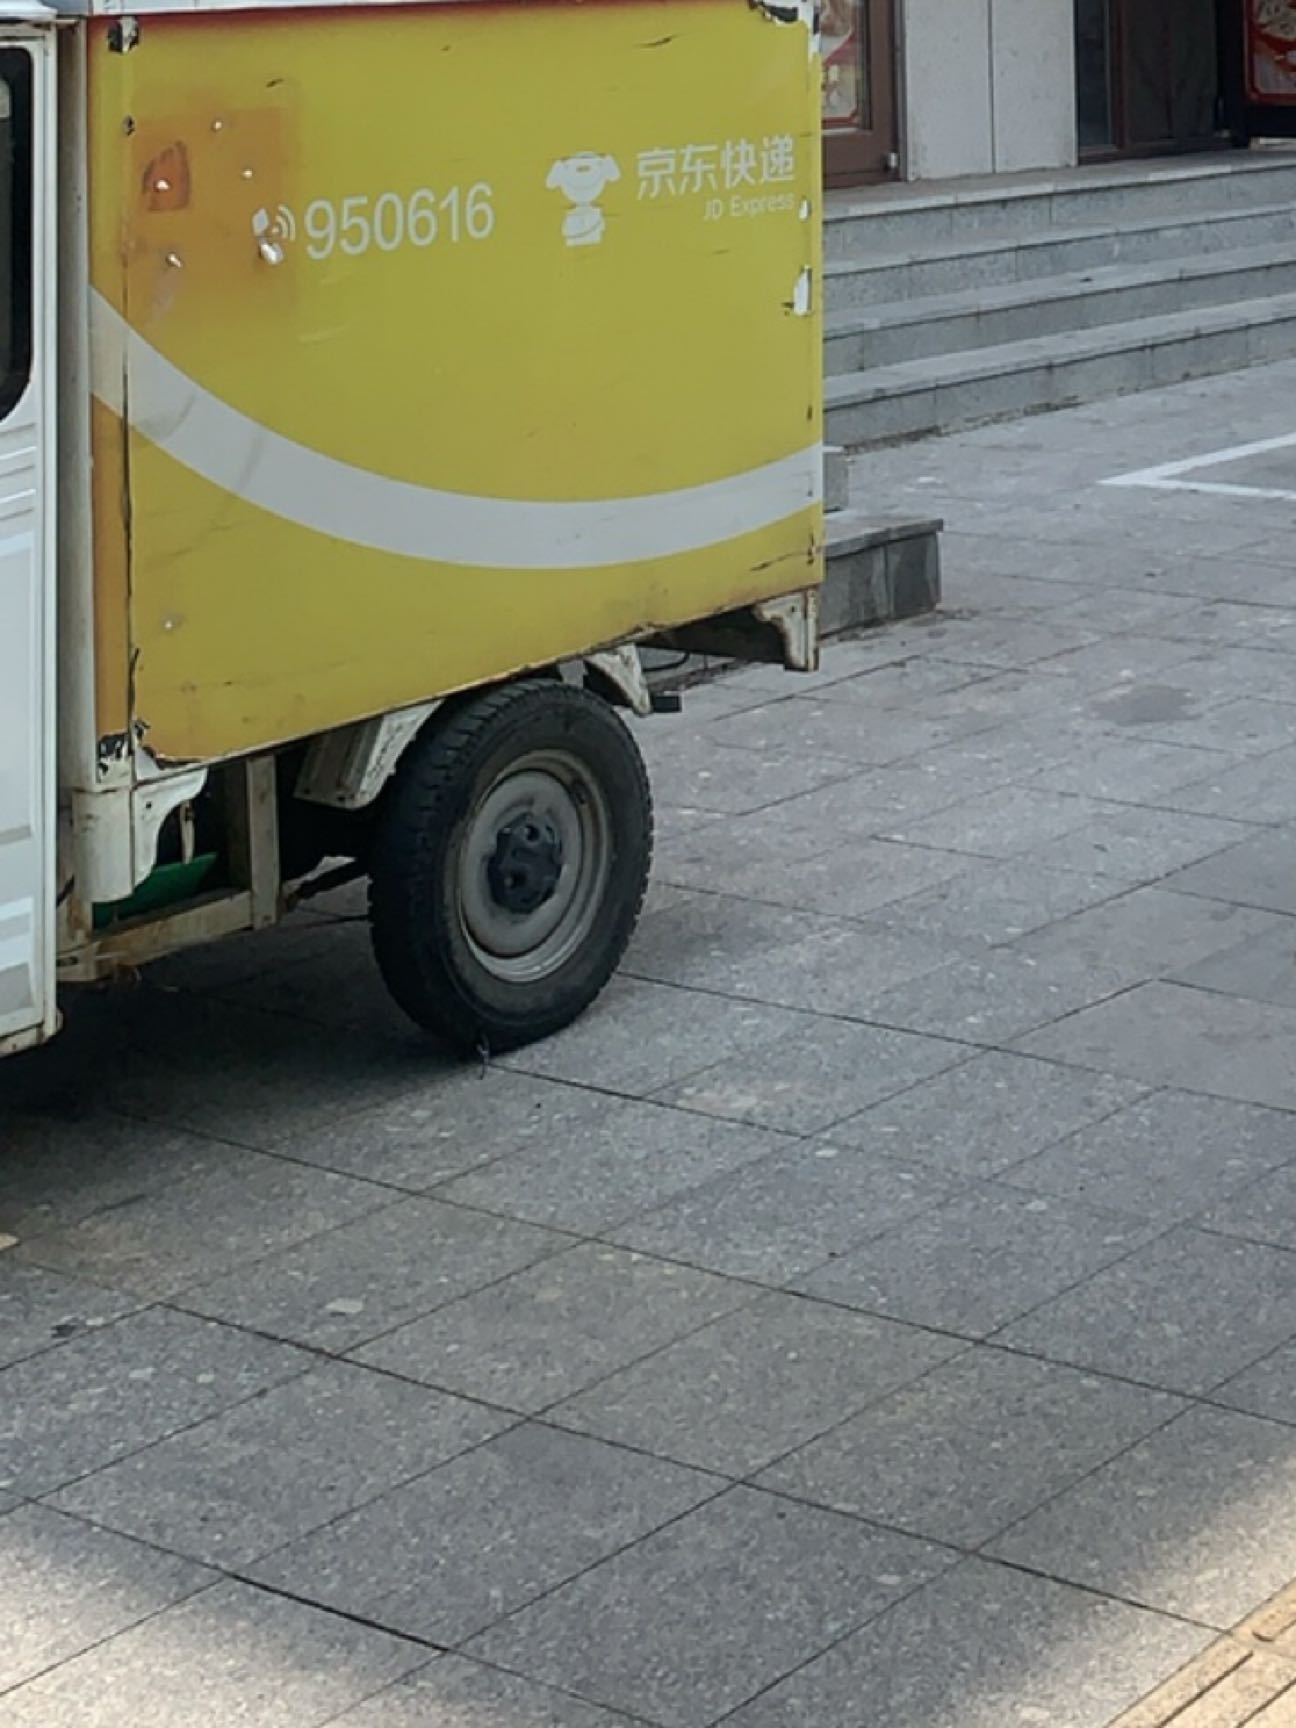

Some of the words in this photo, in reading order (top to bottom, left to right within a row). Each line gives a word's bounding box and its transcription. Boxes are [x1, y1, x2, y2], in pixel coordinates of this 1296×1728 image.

[637, 134, 795, 200] 京东快递
[304, 181, 495, 260] 950616
[731, 192, 795, 216] Express
